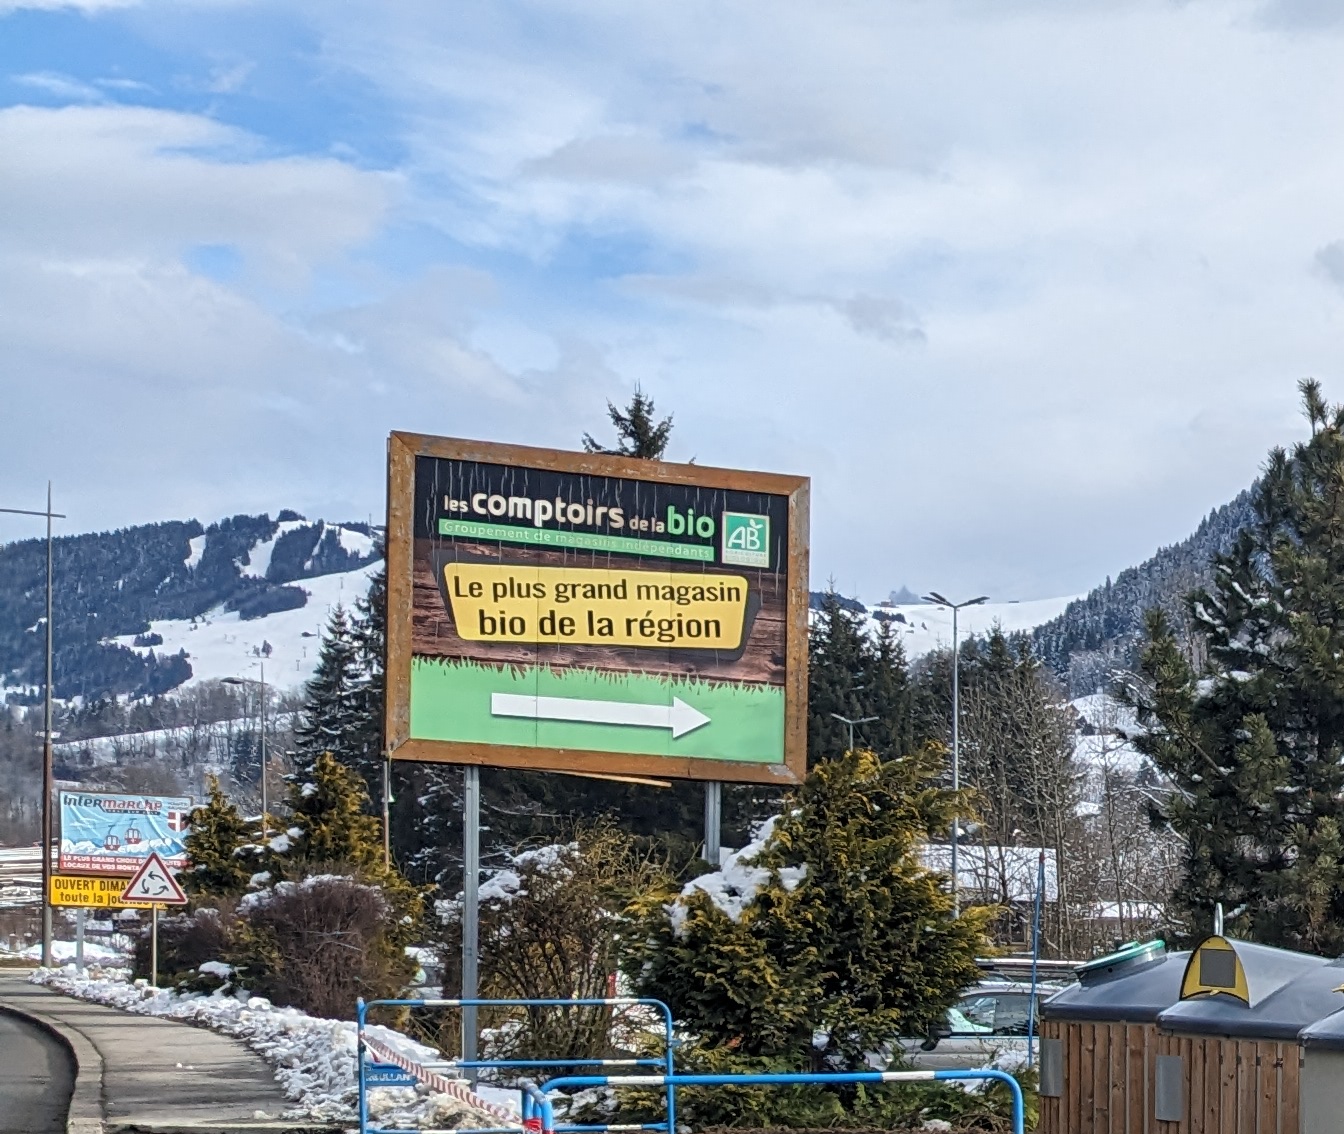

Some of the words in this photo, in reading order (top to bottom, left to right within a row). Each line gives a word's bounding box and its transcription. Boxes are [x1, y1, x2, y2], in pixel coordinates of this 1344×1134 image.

[444, 494, 469, 513] les
[472, 493, 624, 529] comptoirs
[629, 514, 648, 532] de
[651, 516, 665, 533] la
[667, 505, 715, 538] bio
[444, 521, 529, 540] Groupement
[533, 528, 551, 542] de
[555, 534, 616, 549] magasins
[728, 526, 760, 550] AB
[454, 575, 483, 598] Le
[492, 576, 547, 603] plus
[554, 578, 627, 604] grand
[636, 581, 741, 606] magasin
[478, 608, 526, 636] bio
[539, 609, 576, 636] de
[587, 609, 614, 637] la
[625, 609, 721, 643] région
[54, 878, 96, 891] OUVERT
[60, 891, 90, 903] toute
[93, 892, 104, 904] la
